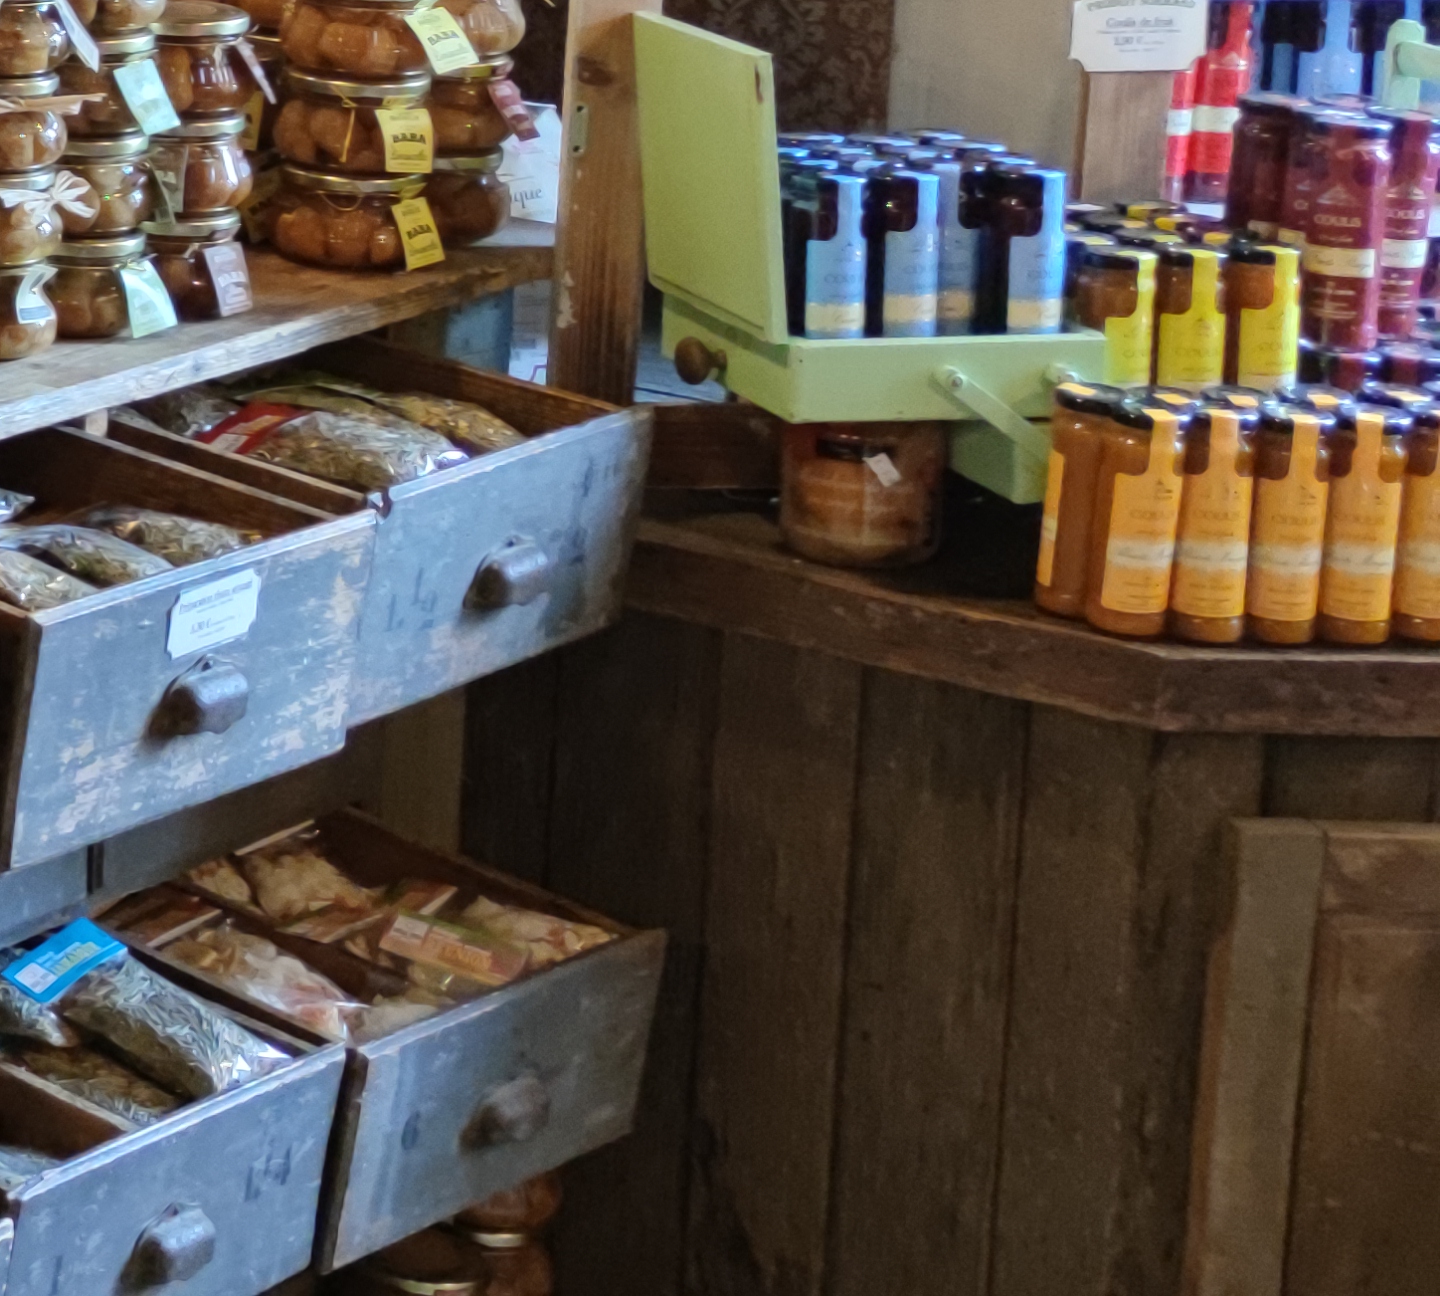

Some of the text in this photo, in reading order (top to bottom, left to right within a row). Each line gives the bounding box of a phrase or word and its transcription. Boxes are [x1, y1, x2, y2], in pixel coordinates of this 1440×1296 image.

[427, 29, 461, 46] BABA
[392, 132, 427, 145] BABA
[1313, 214, 1363, 228] COULIS
[405, 223, 434, 241] BABA
